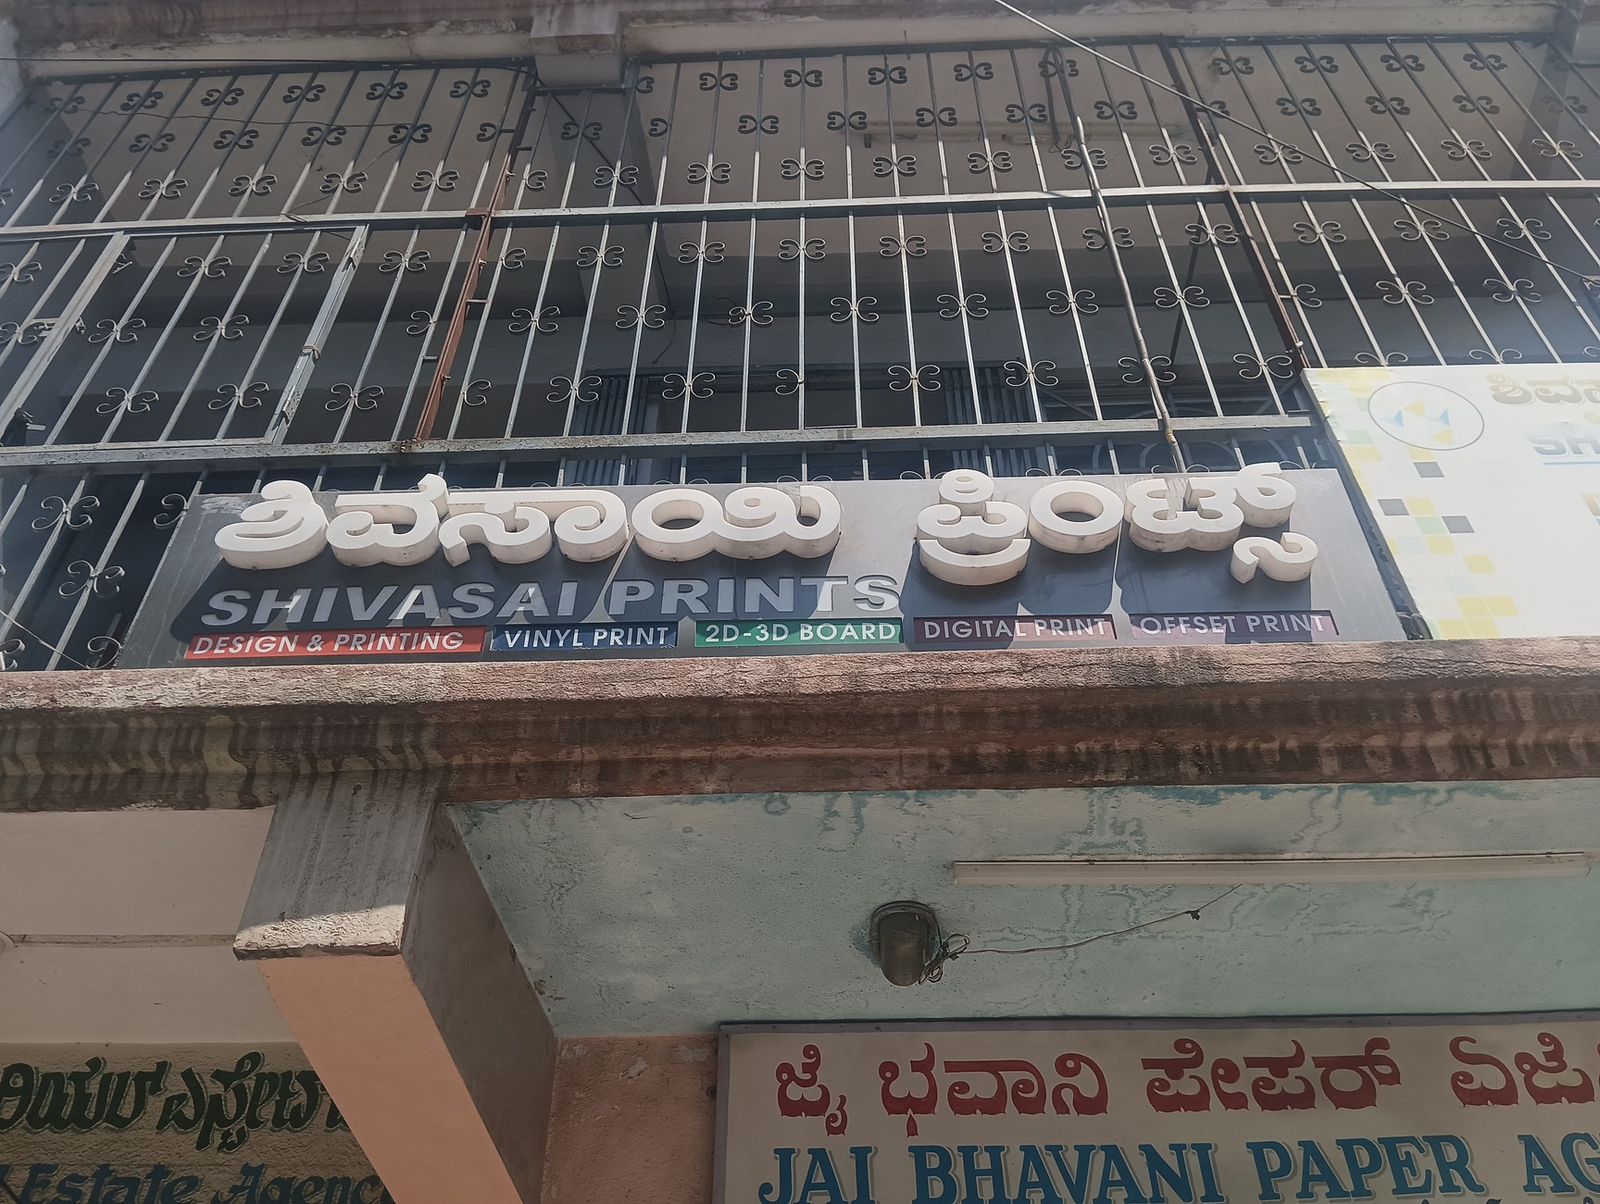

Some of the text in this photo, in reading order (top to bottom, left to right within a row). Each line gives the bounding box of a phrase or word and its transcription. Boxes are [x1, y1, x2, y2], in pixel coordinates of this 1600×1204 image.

[215, 474, 842, 570] ಶಿವಸಾಯಿ
[200, 576, 901, 626] SHIVASAI PRINTS
[504, 627, 669, 648] VINYL PRINT
[705, 622, 897, 643] 2D-3D BOARD
[924, 617, 1106, 639] DIGITAL PRINT
[1140, 614, 1327, 636] OFFSET PRINT
[193, 631, 465, 655] DESIGN & PRINTING
[775, 1031, 1600, 1138] ಜೈ ಭವಾನಿ ಪೇಪರ್ ಏಜೆ
[212, 1162, 398, 1204] Agenc
[758, 1147, 873, 1204] JAI
[907, 1142, 1226, 1204] BHAVANI
[1245, 1135, 1485, 1201] PAPER
